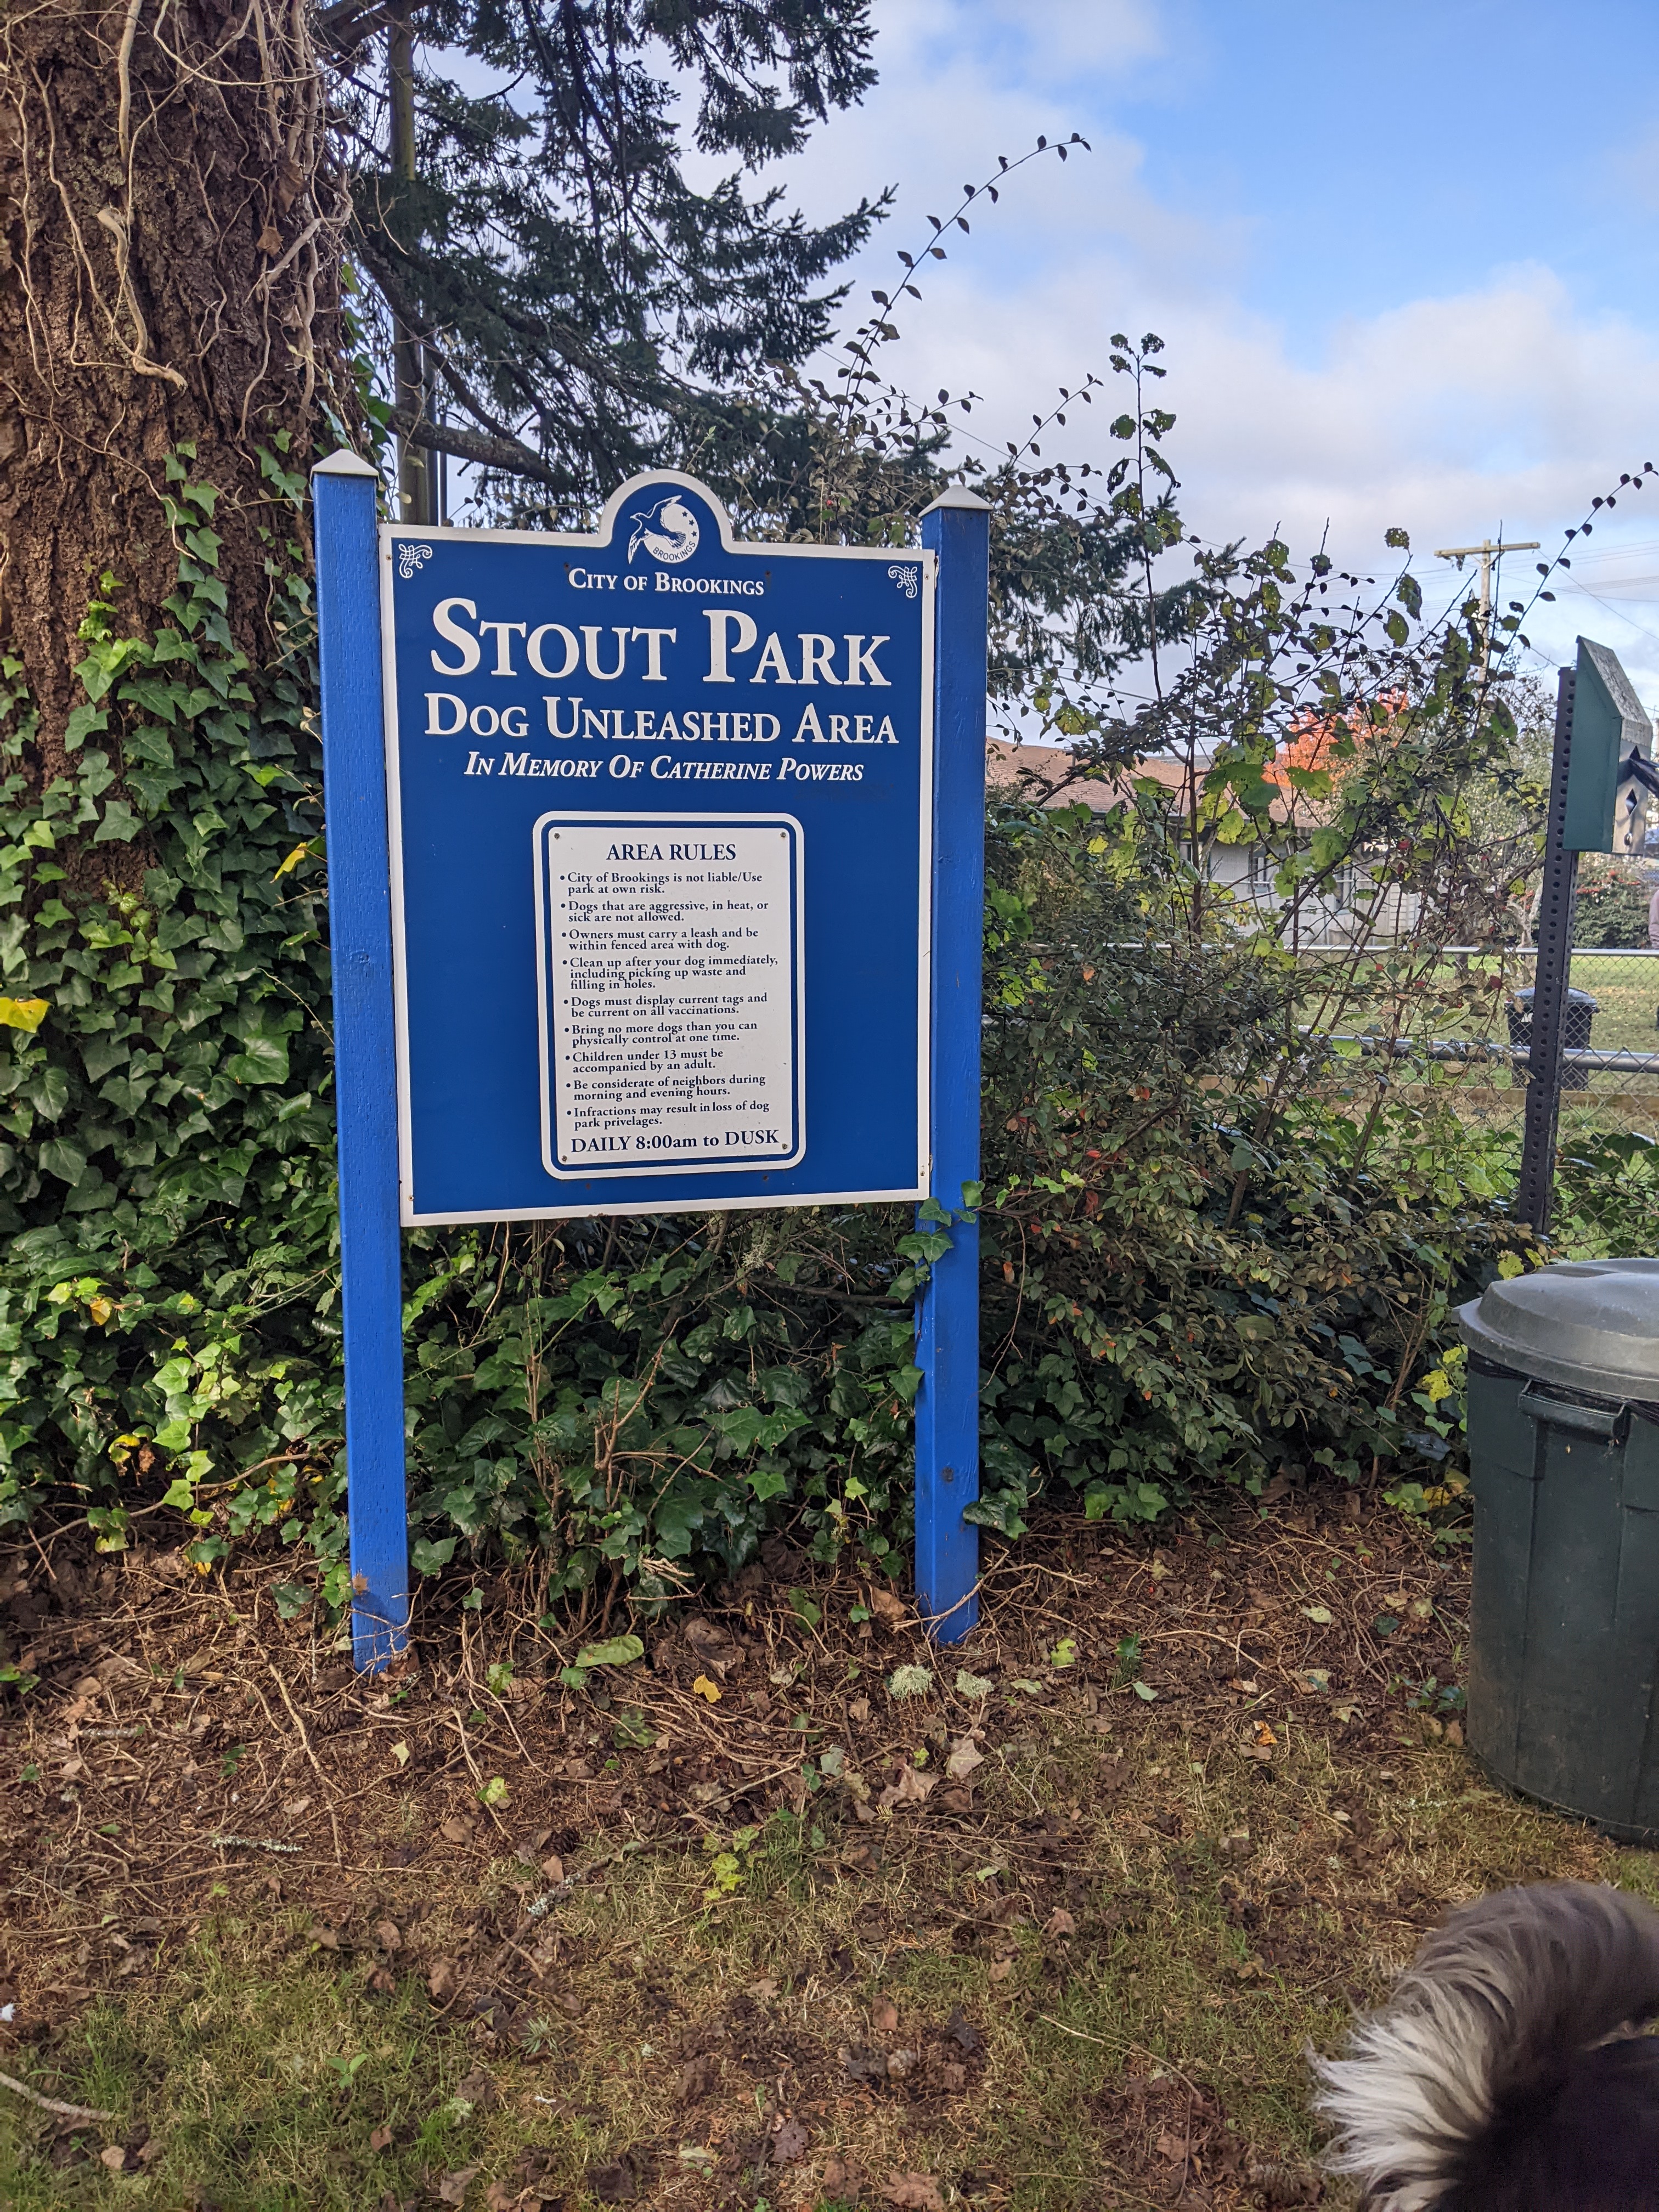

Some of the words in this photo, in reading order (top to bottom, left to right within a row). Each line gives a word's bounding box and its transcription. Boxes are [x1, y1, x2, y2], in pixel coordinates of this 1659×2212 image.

[652, 540, 696, 561] BROOKINGS
[569, 568, 618, 589] CITY
[624, 576, 647, 590] OF
[655, 572, 764, 595] BROOKINGS
[431, 598, 676, 680] STOUT
[703, 610, 891, 685] PARK
[424, 693, 529, 736] DOG
[543, 696, 780, 741] UNLEASHED
[792, 703, 899, 743] AREA
[464, 752, 495, 775] IN
[498, 753, 603, 777] MEMORY
[610, 755, 644, 778] OF
[651, 755, 772, 779] CATHERINE
[776, 758, 864, 780] POWERS
[606, 844, 664, 860] AREA
[669, 844, 736, 860] RULES
[568, 872, 592, 883] City
[596, 872, 608, 882] of
[612, 872, 669, 885] Brookings
[674, 873, 681, 882] is
[708, 872, 761, 882] liable/Use
[568, 883, 594, 896] park
[641, 883, 664, 893] risk.
[568, 901, 598, 914] Dogs
[602, 901, 624, 910] that
[650, 901, 708, 913] aggressive,
[713, 901, 723, 910] in
[727, 900, 753, 910] heat,
[568, 911, 591, 922] sick
[638, 911, 684, 921] allowed.
[569, 929, 613, 939] Owners
[649, 932, 677, 940] carry
[691, 928, 718, 937] leash
[723, 927, 742, 937] and
[746, 927, 758, 936] be
[569, 940, 607, 950] within
[612, 939, 647, 949] fenced
[678, 939, 702, 948] with
[707, 939, 729, 951] dog.
[571, 957, 603, 967] Clean
[607, 961, 622, 970] up
[626, 956, 651, 966] after
[653, 960, 681, 970] your
[685, 956, 704, 968] dog
[709, 955, 777, 967] immediately,
[570, 968, 625, 981] including
[628, 967, 671, 981] picking
[675, 970, 688, 979] up
[726, 966, 746, 975] and
[570, 979, 606, 992] filling
[610, 980, 619, 989] in
[623, 978, 656, 988] holes.
[572, 997, 600, 1009] Dogs
[636, 995, 675, 1007] display
[723, 996, 743, 1006] tags
[748, 992, 767, 1002] and
[572, 1008, 584, 1017] be
[651, 1006, 664, 1015] all
[668, 1005, 738, 1014] vaccinations.
[572, 1024, 605, 1037] Bring
[658, 1022, 682, 1035] dogs
[687, 1022, 711, 1031] than
[715, 1024, 735, 1033] you
[573, 1034, 629, 1048] physically
[633, 1033, 672, 1043] control
[573, 1051, 623, 1062] Children
[628, 1050, 659, 1060] under
[665, 1050, 676, 1059] 13
[711, 1048, 723, 1057] be
[573, 1061, 646, 1075] accompanied
[651, 1061, 663, 1073] by
[685, 1059, 715, 1069] adult.
[574, 1080, 588, 1089] Be
[592, 1078, 654, 1088] considerate
[658, 1076, 670, 1086] of
[673, 1075, 725, 1088] neighbors
[730, 1074, 765, 1086] during
[574, 1091, 622, 1102] morning
[626, 1088, 646, 1098] and
[651, 1088, 693, 1099] evening
[697, 1086, 730, 1095] hours.
[574, 1107, 636, 1116] Infractions
[640, 1108, 663, 1116] may
[667, 1103, 697, 1113] result
[700, 1103, 710, 1111] in
[713, 1102, 731, 1111] loss
[736, 1101, 747, 1110] of
[750, 1101, 769, 1112] dog
[575, 1118, 600, 1131] park
[605, 1116, 662, 1130] privelages.
[571, 1136, 631, 1152] DAILY
[636, 1135, 697, 1149] 8:00am
[703, 1136, 719, 1146] to
[725, 1130, 779, 1145] DUSK
